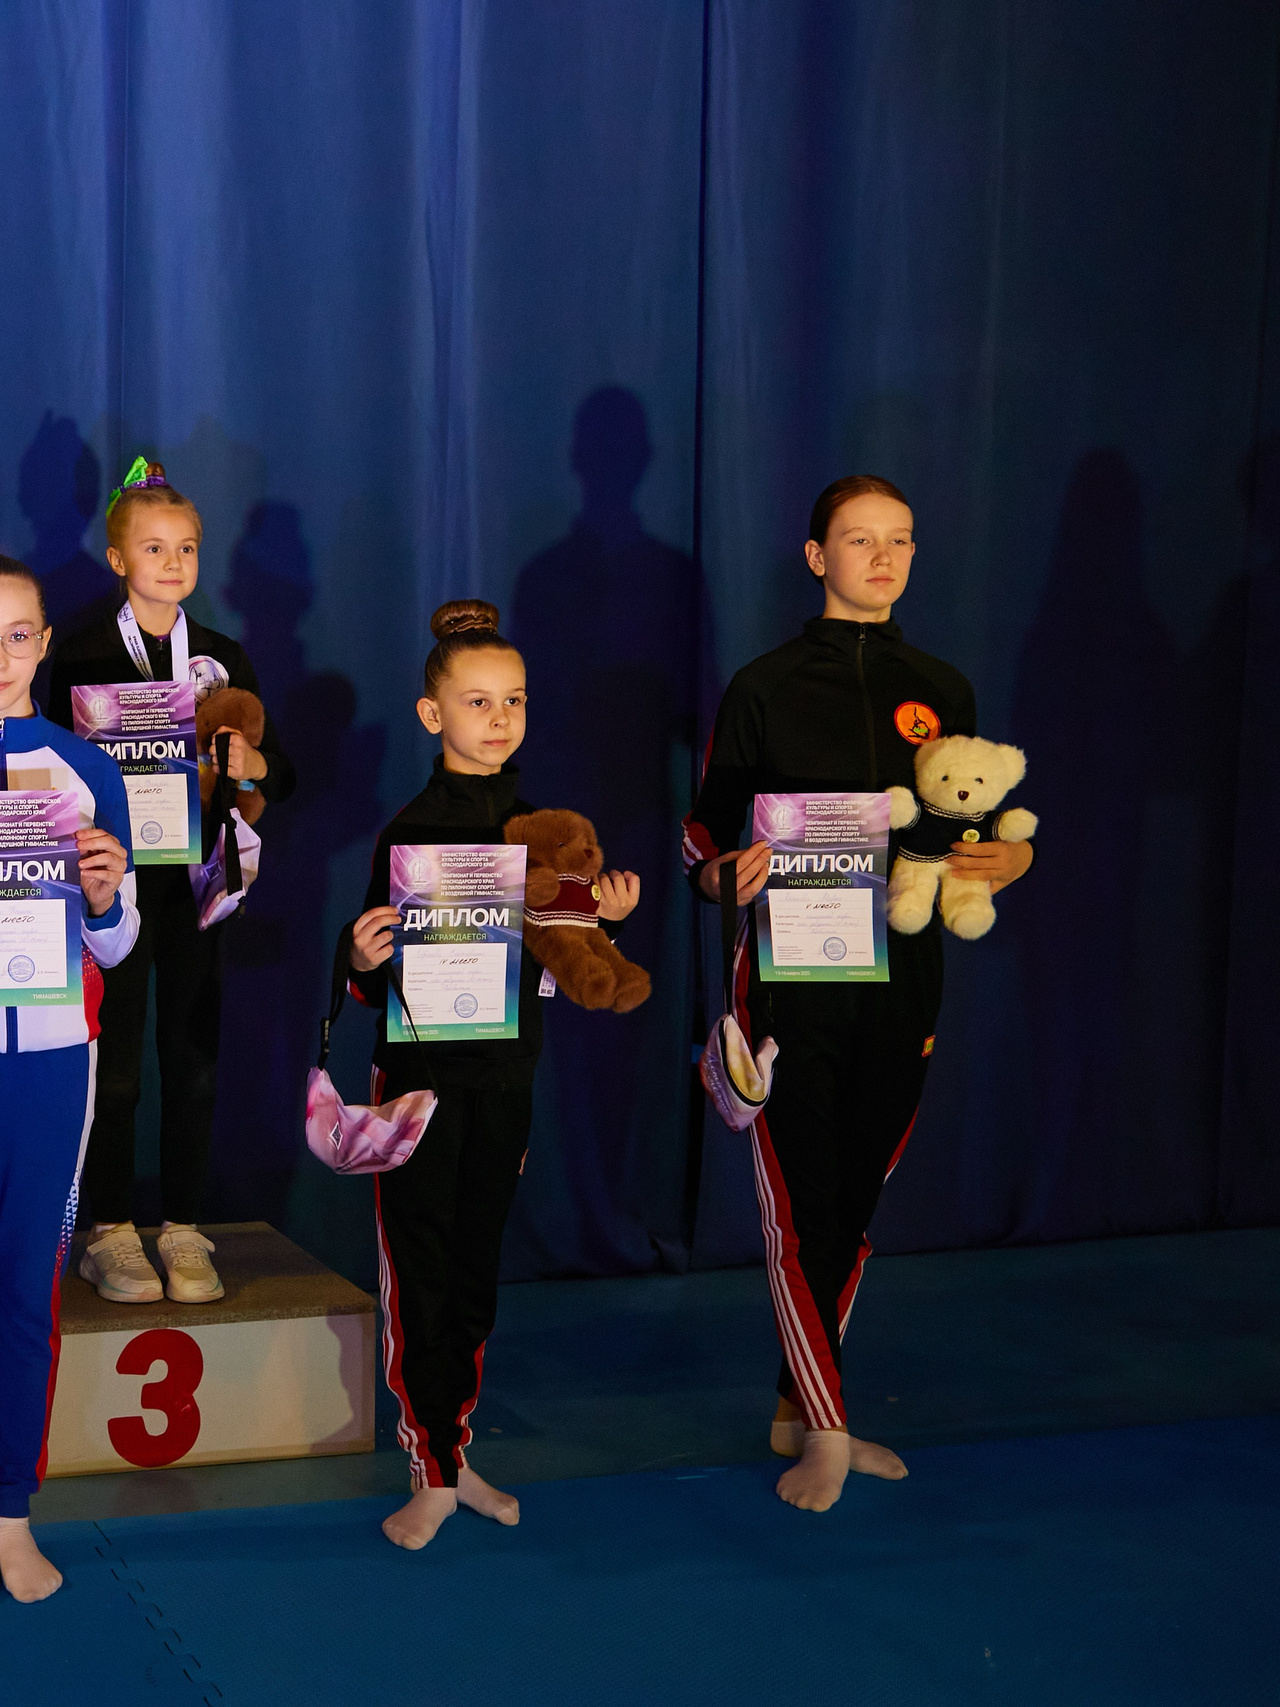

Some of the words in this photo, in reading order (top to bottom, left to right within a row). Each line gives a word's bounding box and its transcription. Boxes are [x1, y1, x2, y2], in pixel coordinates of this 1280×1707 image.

[97, 740, 186, 760] ИПЛОМ
[768, 854, 873, 876] ДИПЛОМ
[404, 908, 509, 931] ДИПЛОМ
[424, 933, 487, 942] НАГРАЖДАЕТСЯ
[108, 1327, 203, 1465] 3
